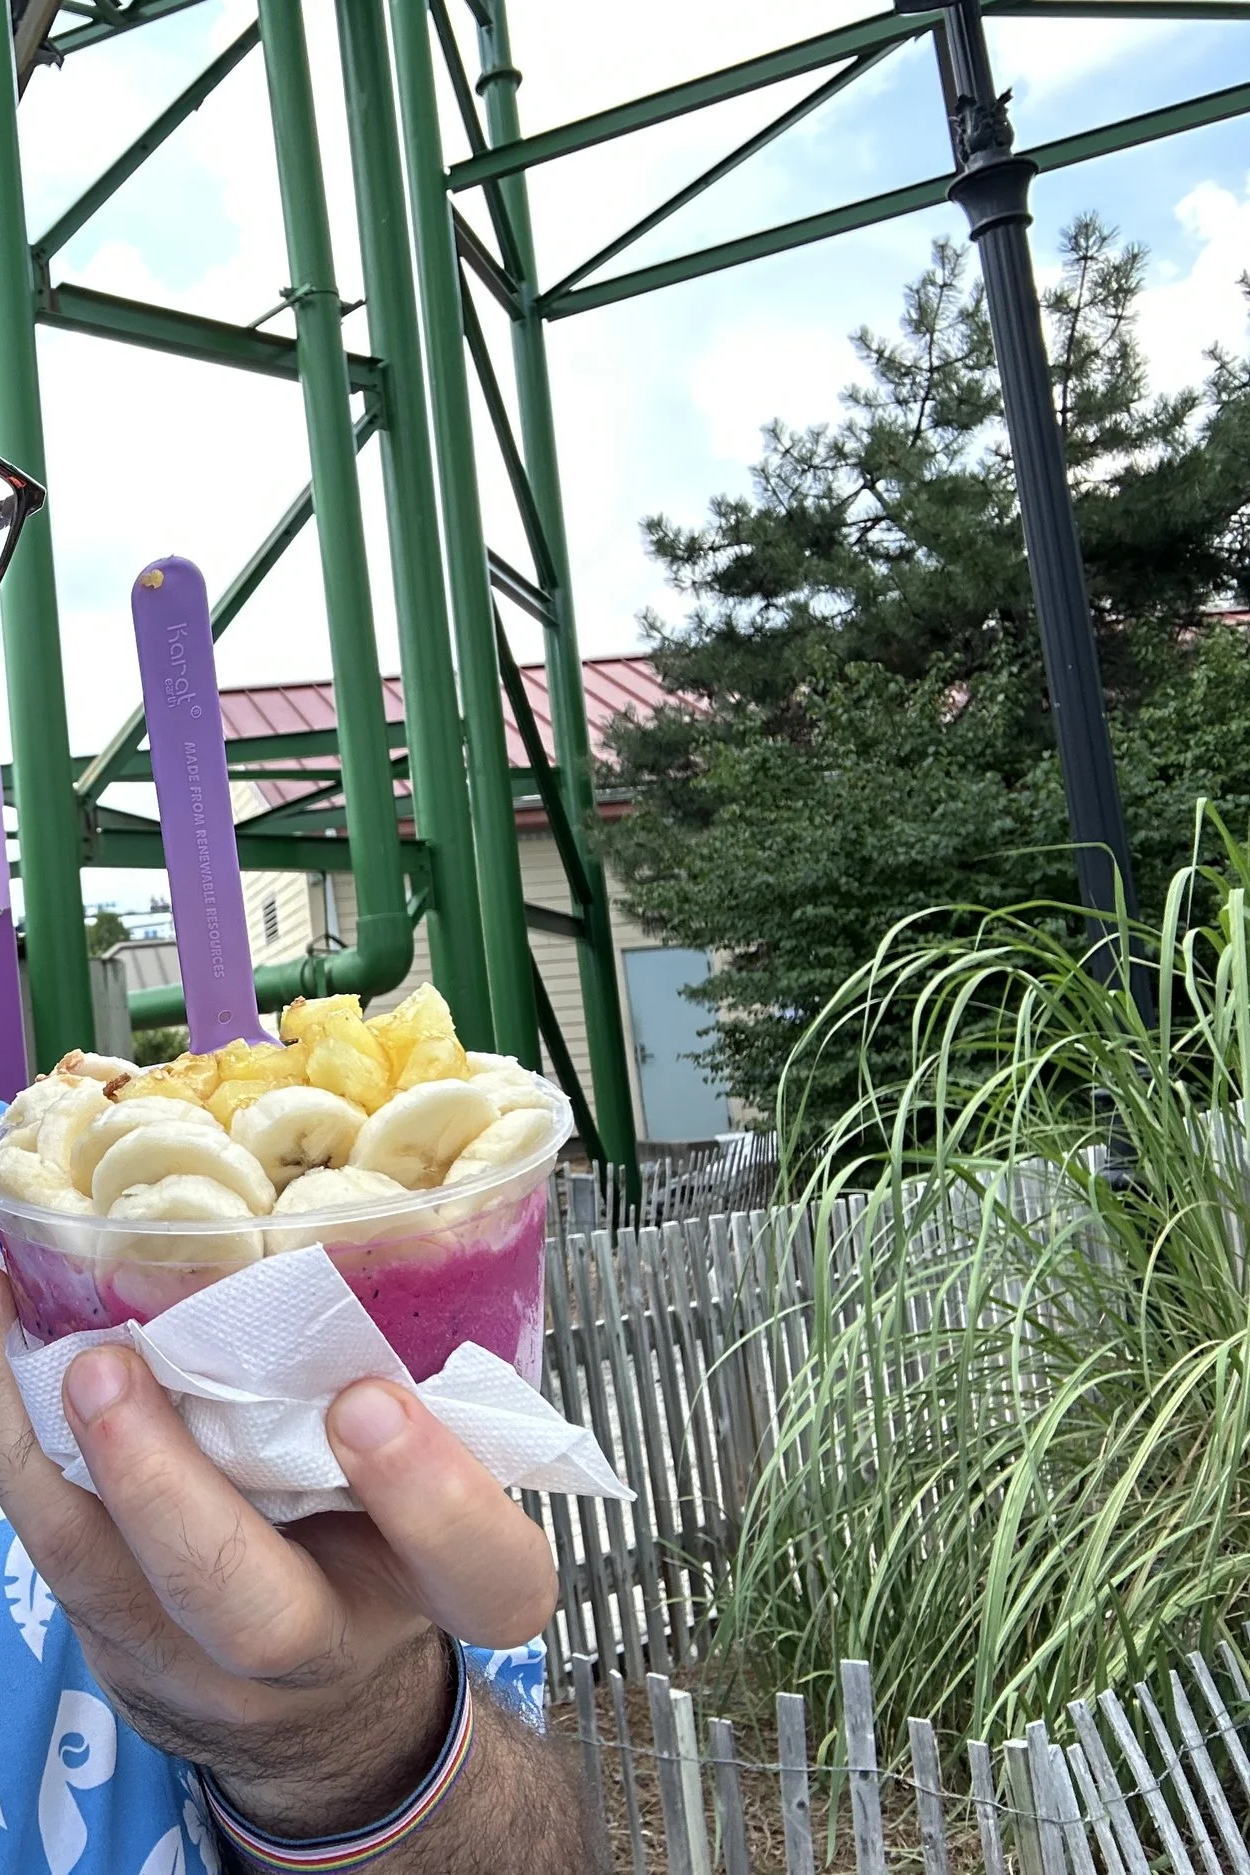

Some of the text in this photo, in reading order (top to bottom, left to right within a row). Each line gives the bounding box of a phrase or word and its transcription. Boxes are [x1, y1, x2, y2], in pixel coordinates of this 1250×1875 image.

[164, 677, 176, 708] earth
[183, 741, 225, 979] MADE FROM RENEWABLE RESOURCES
